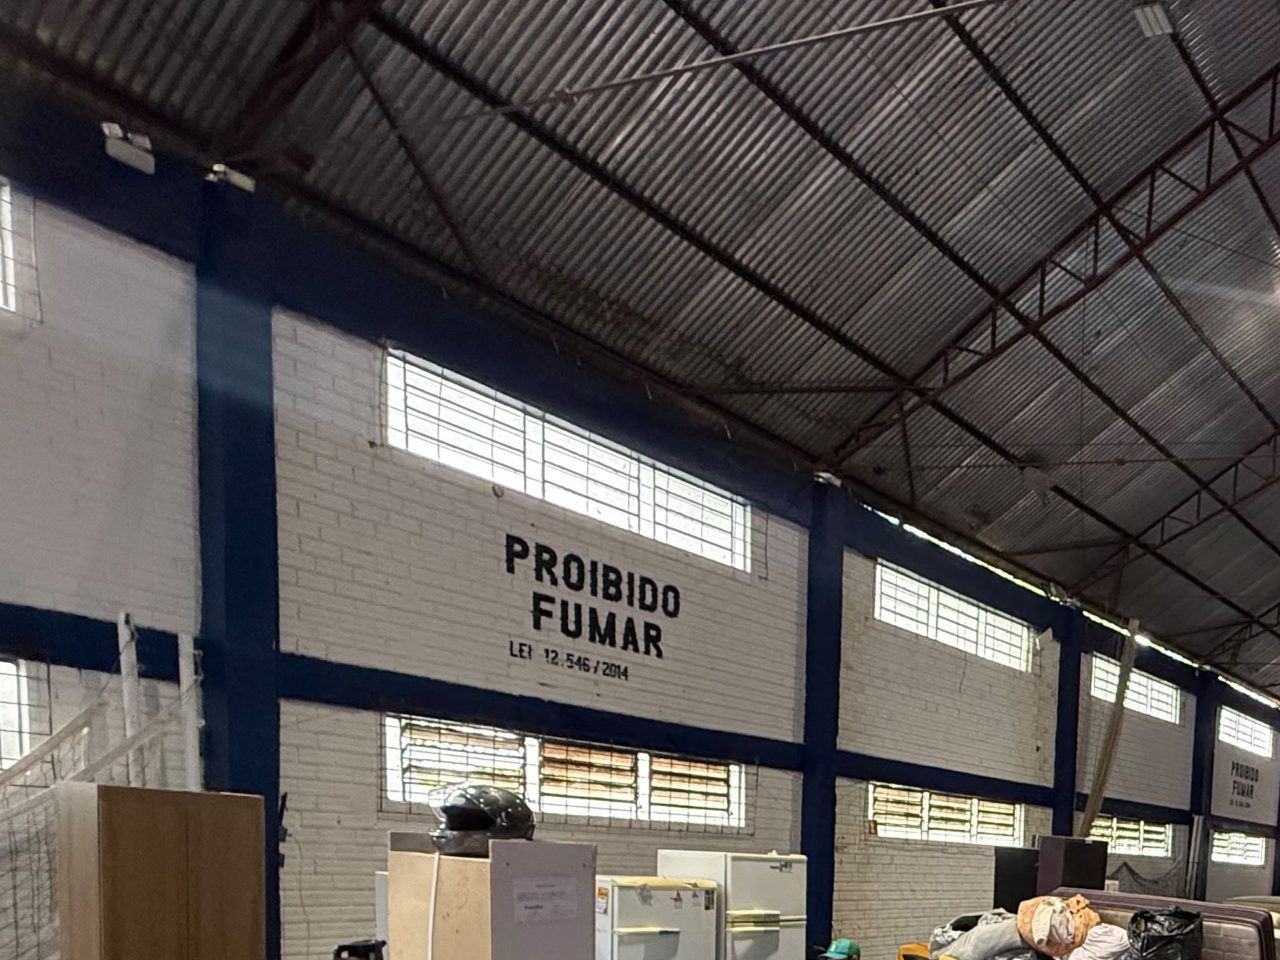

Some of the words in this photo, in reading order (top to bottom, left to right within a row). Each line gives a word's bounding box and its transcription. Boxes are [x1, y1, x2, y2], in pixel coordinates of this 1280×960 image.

[505, 532, 681, 619] PROIBIDO
[531, 591, 664, 659] FUMAR
[509, 640, 533, 660] LEI
[1231, 761, 1259, 783] PROIBIDO
[1232, 780, 1254, 799] FUMAR
